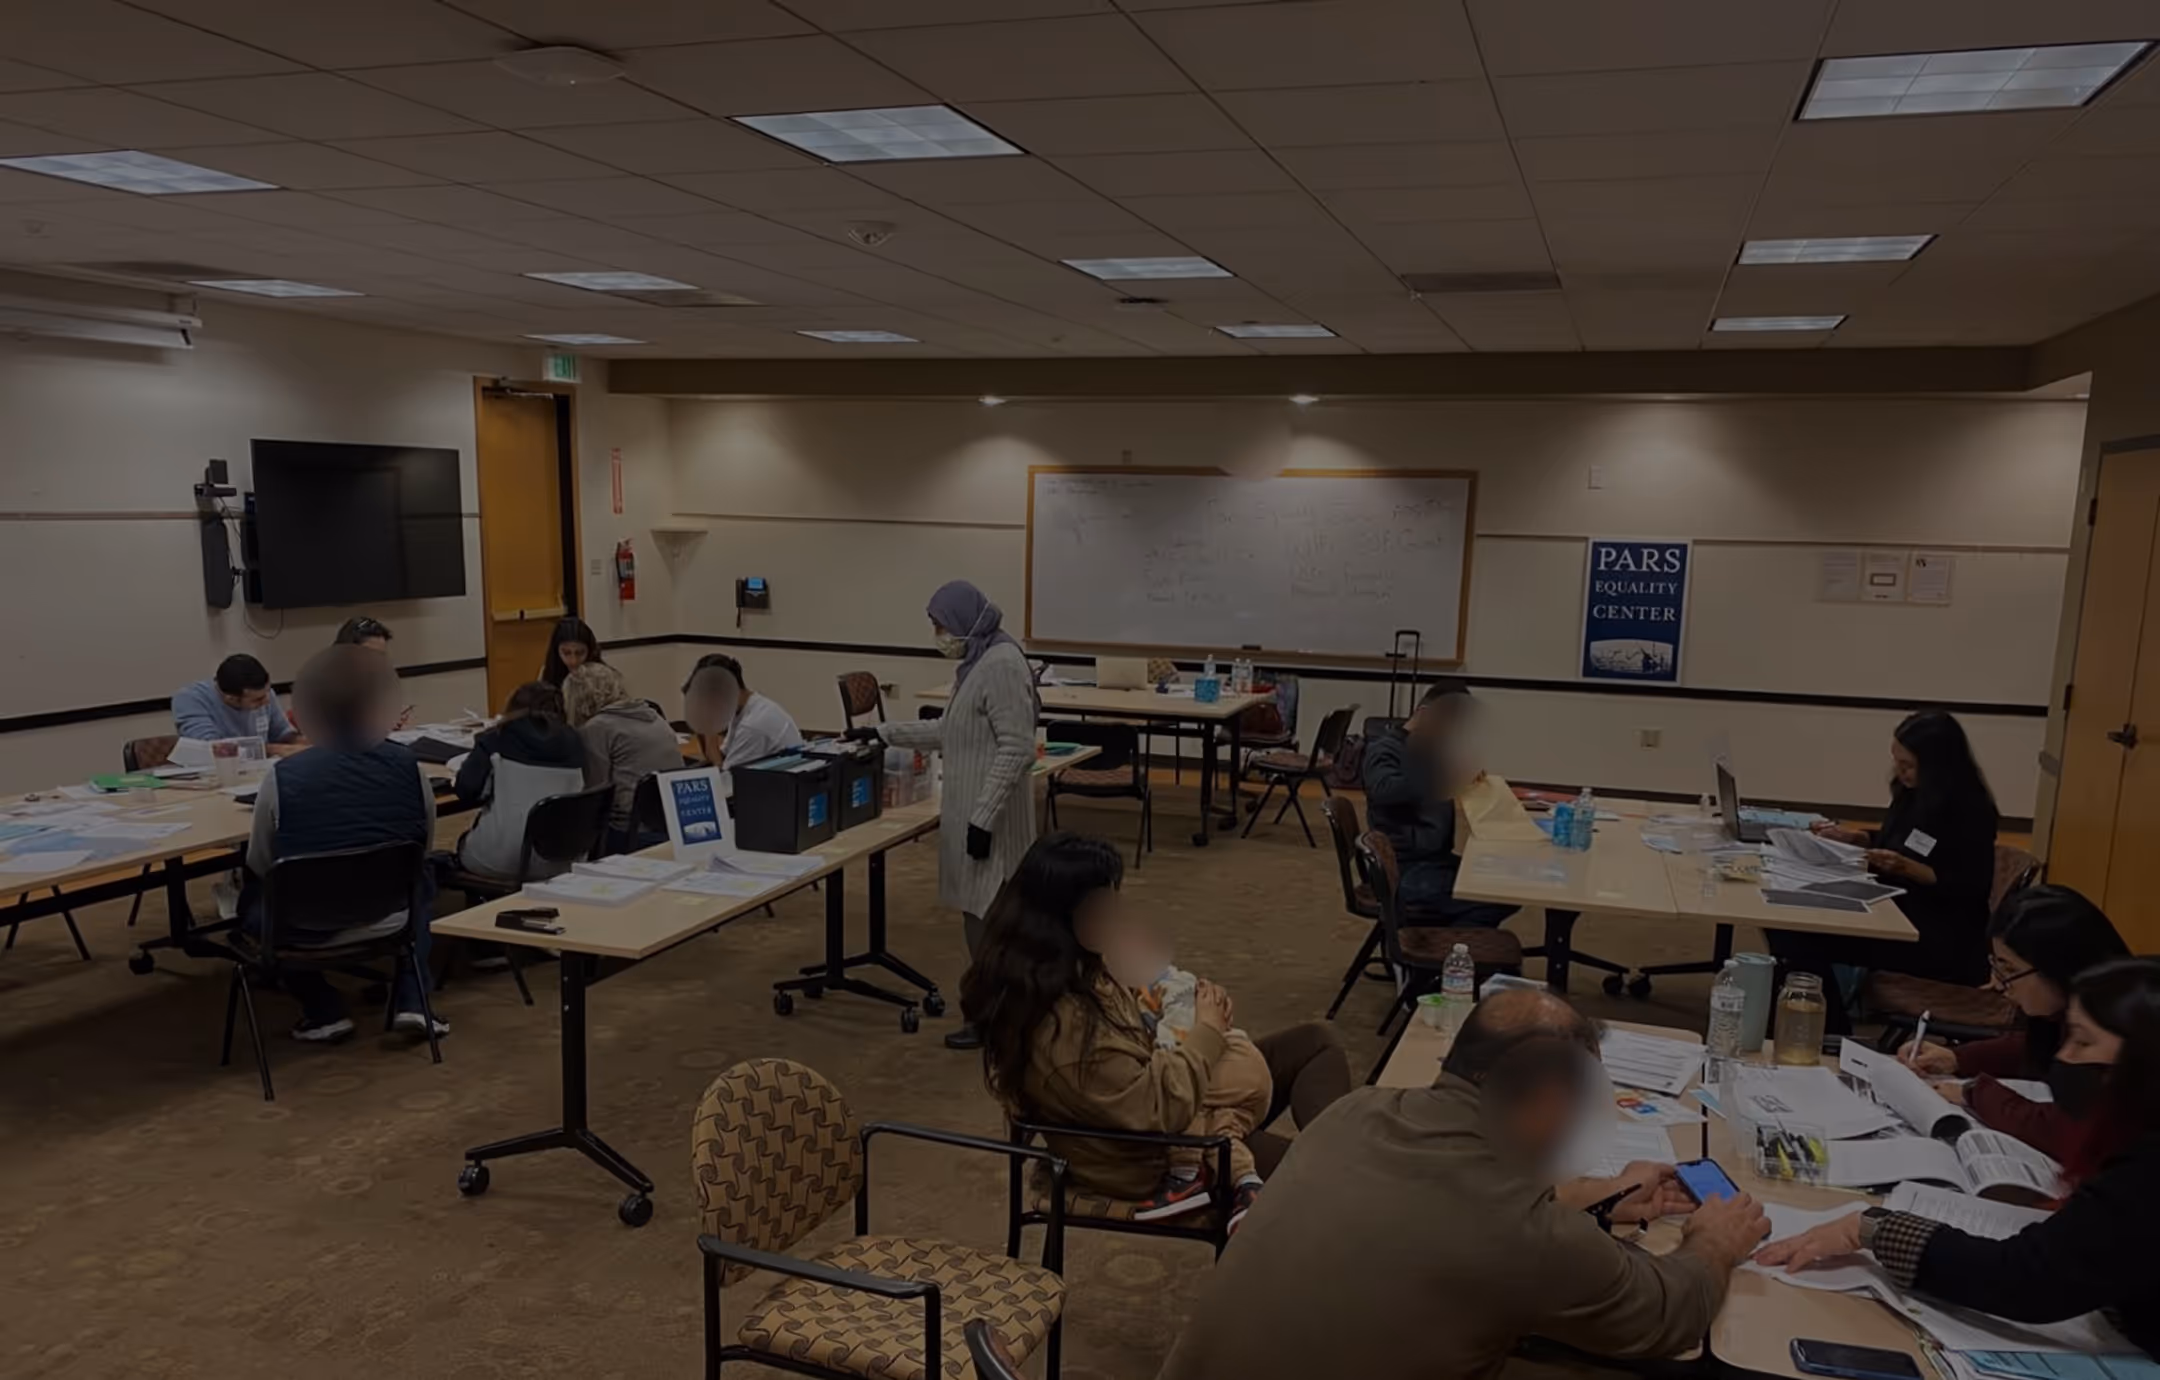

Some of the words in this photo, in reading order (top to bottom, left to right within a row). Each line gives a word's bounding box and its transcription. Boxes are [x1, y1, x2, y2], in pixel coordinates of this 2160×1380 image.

[1597, 546, 1681, 574] PARS
[1595, 580, 1678, 596] EQUALITY
[1592, 604, 1676, 622] CENTER
[676, 780, 708, 793] PARS
